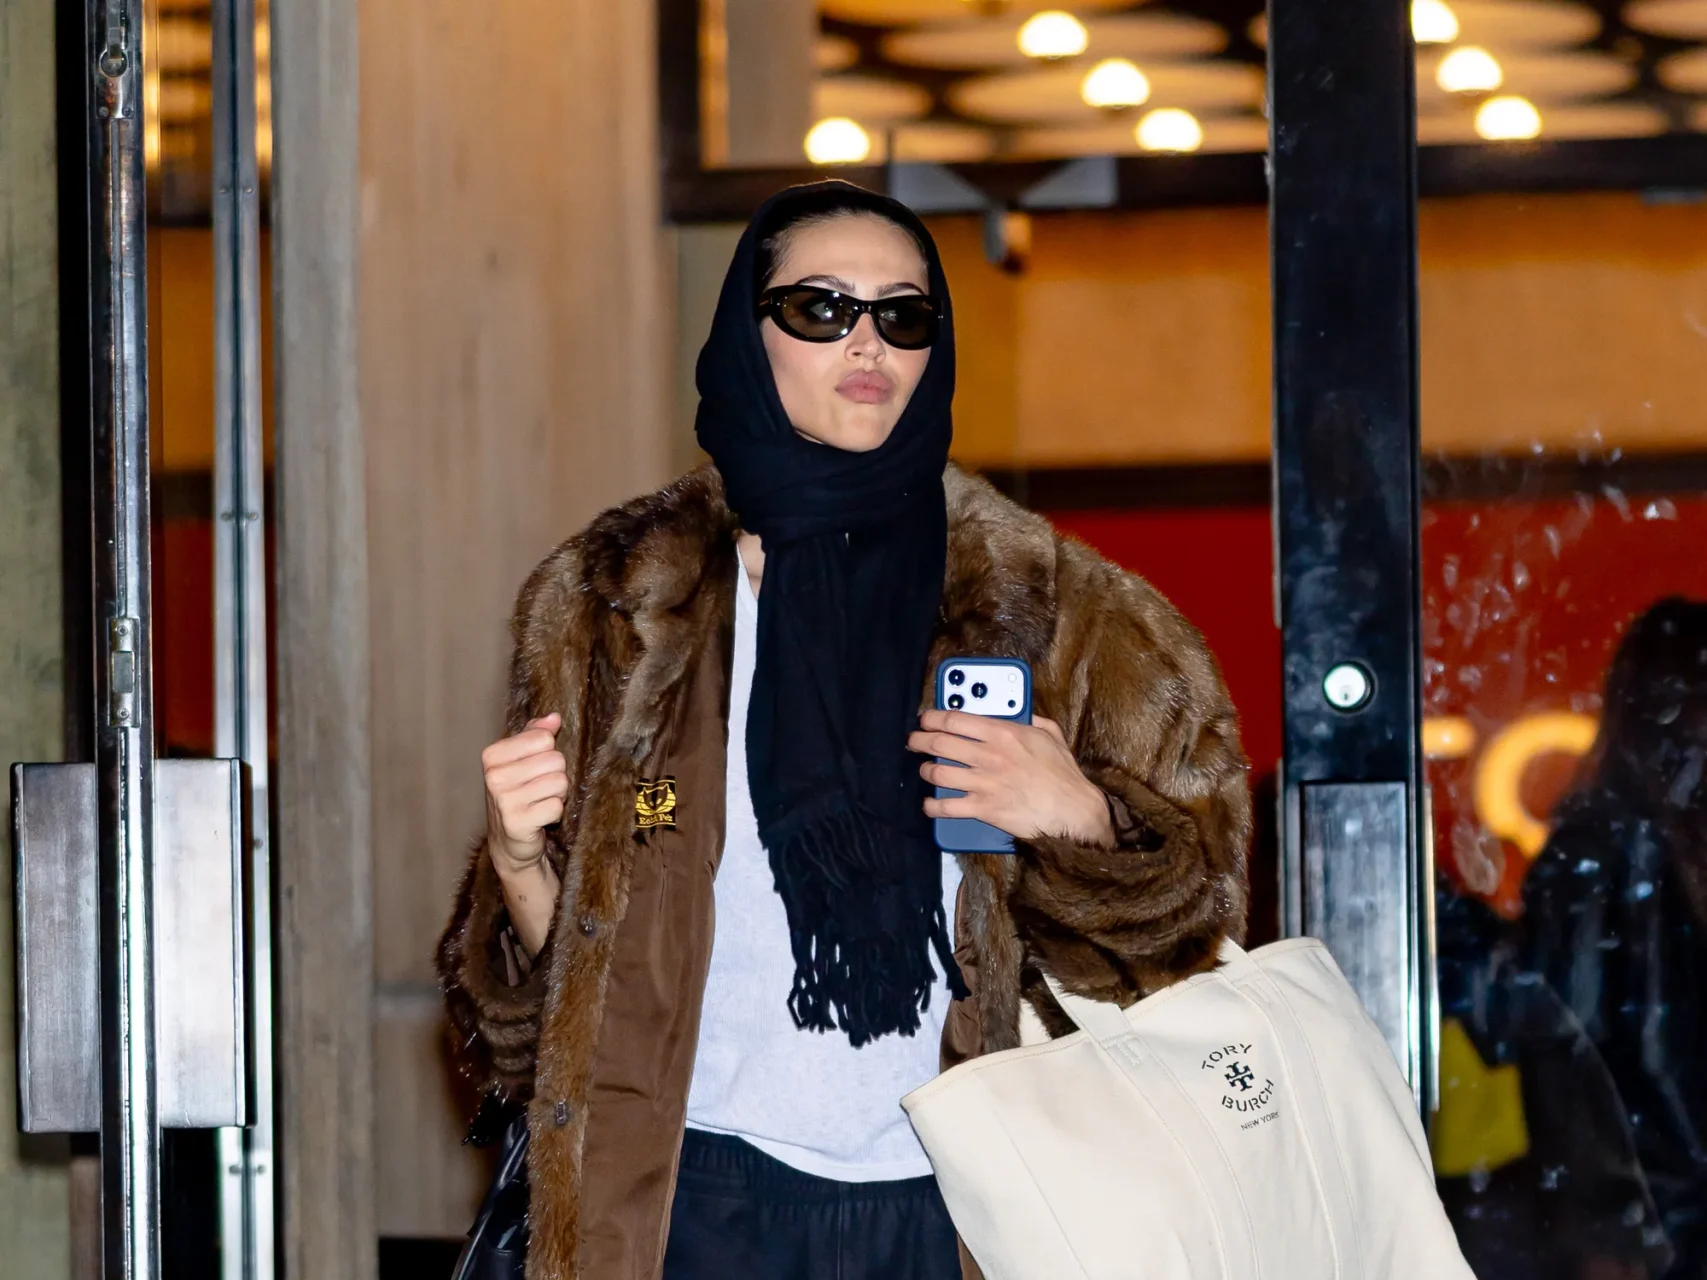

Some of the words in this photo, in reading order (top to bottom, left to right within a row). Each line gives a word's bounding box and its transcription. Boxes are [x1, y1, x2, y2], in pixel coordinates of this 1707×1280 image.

[1201, 1043, 1252, 1070] TORY
[1221, 1078, 1274, 1112] BURCH
[1241, 1118, 1260, 1131] NEW
[1260, 1111, 1280, 1124] YORK
